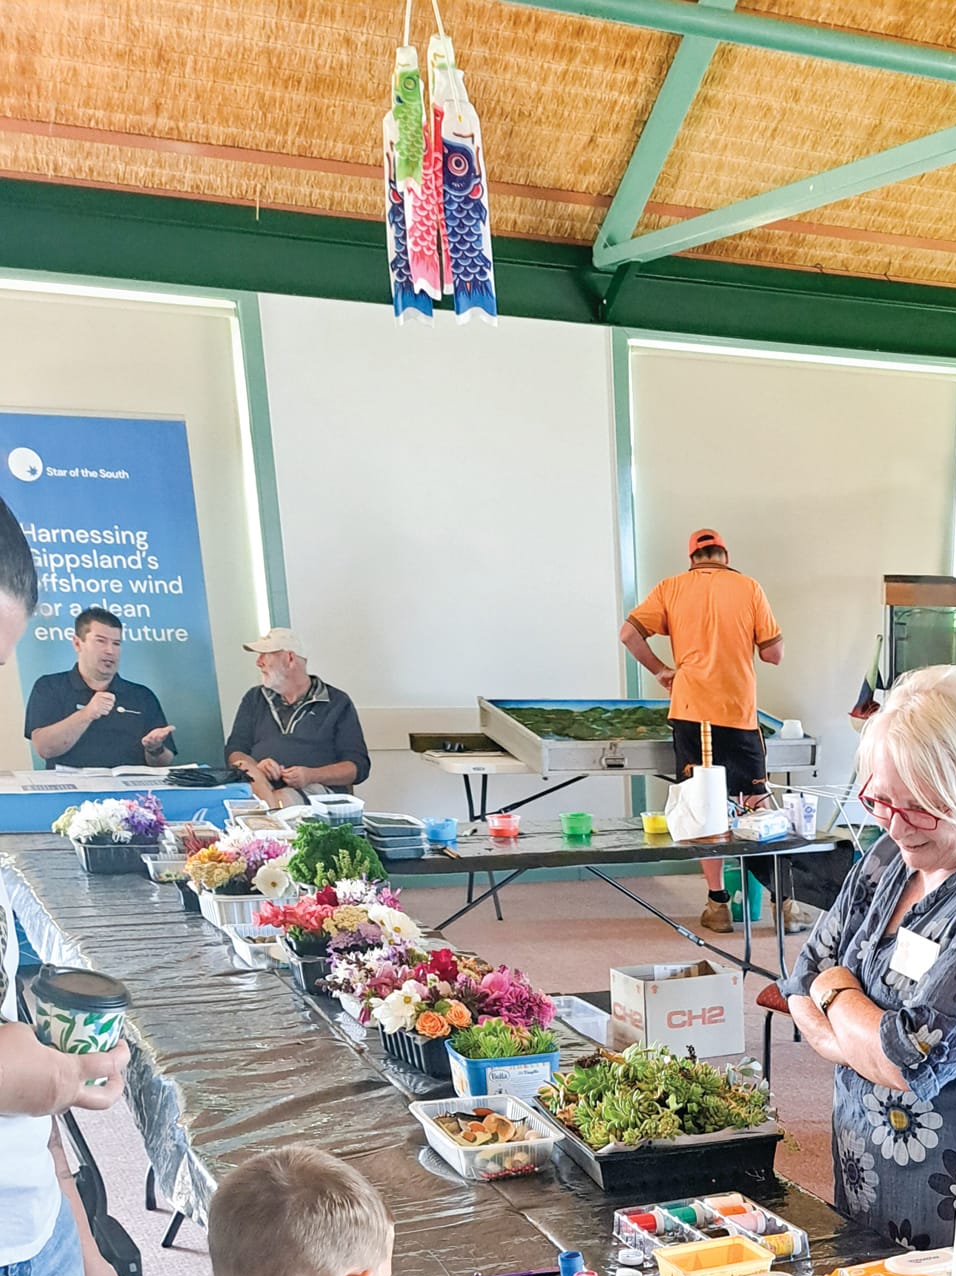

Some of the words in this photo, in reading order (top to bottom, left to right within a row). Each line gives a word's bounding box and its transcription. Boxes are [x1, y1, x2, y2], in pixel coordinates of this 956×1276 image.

[46, 466, 68, 477] Star
[69, 467, 79, 477] of
[80, 467, 98, 478] the
[99, 468, 130, 479] South
[20, 522, 149, 550] Harnessing
[38, 573, 123, 593] ffshore
[129, 575, 184, 594] wind
[34, 602, 62, 617] or
[69, 602, 83, 617] a
[122, 622, 189, 642] future
[666, 1005, 726, 1029] CH2
